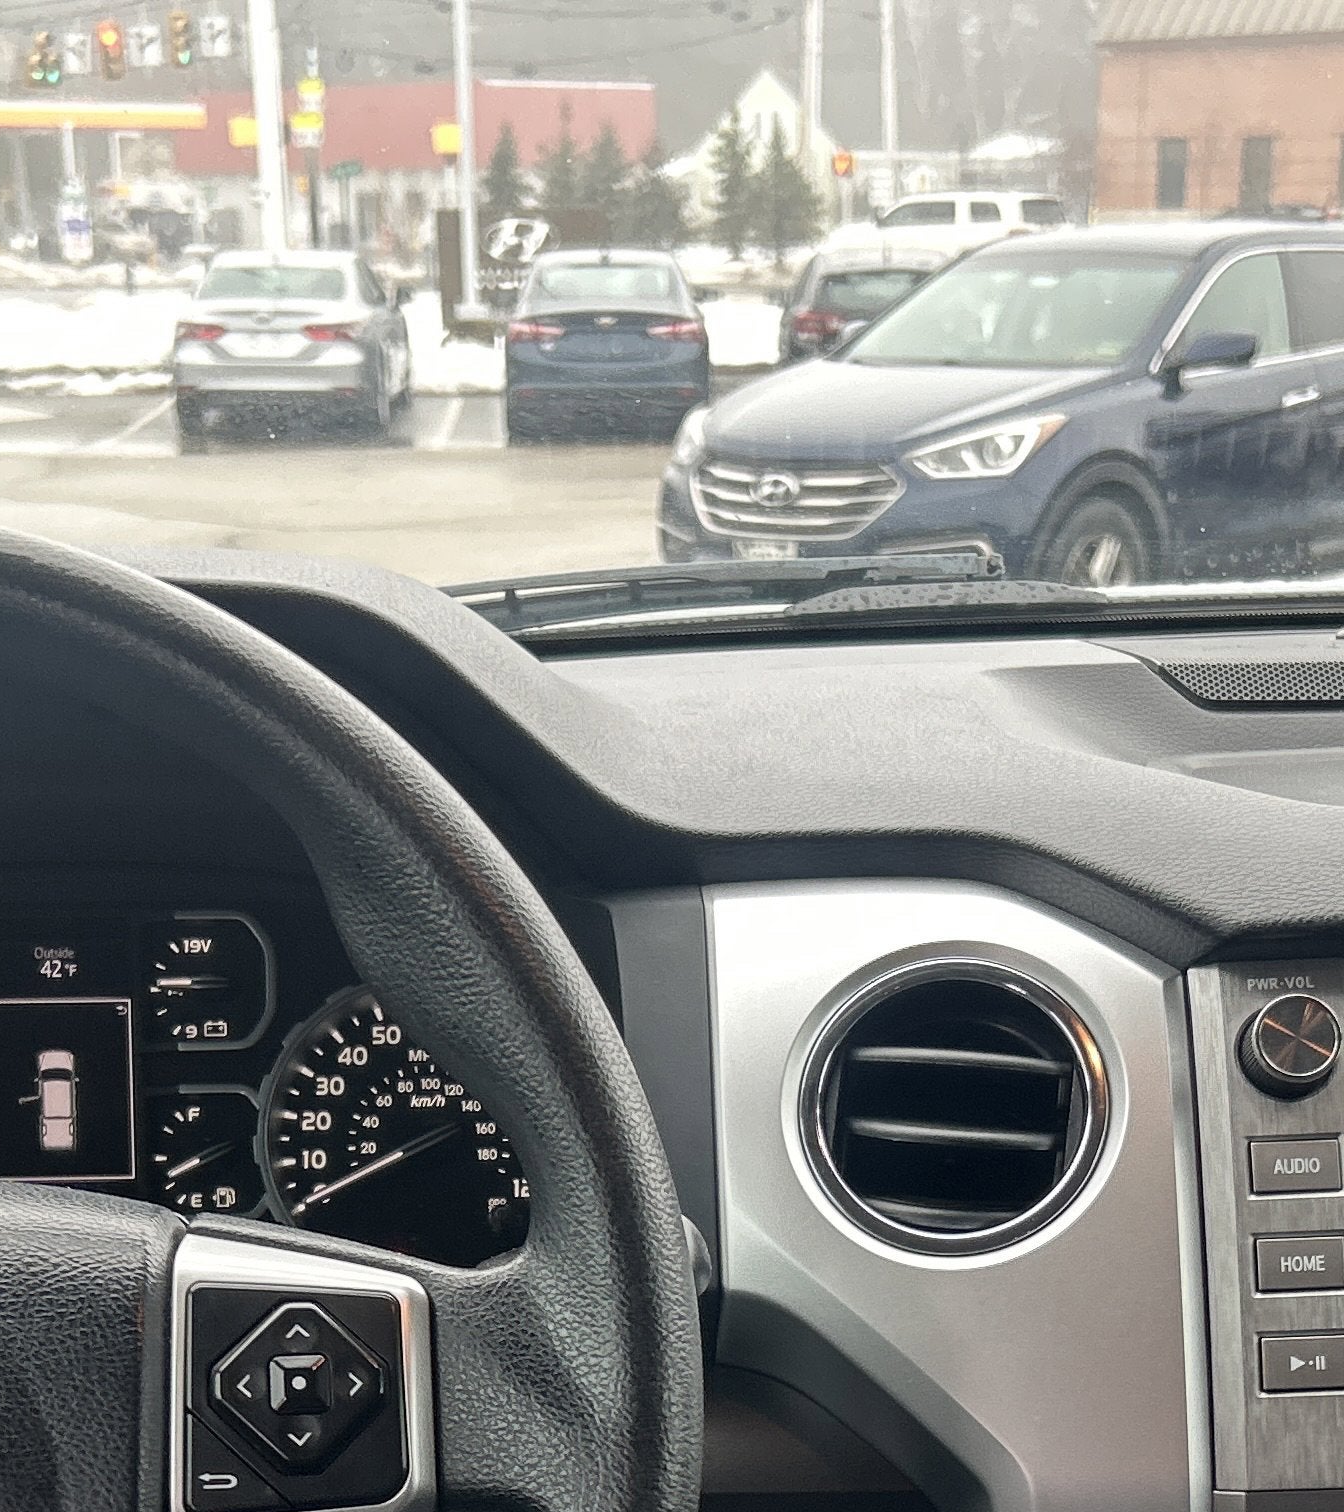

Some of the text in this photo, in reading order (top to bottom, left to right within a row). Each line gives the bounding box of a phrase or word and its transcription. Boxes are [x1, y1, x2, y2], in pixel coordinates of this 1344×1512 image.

[33, 946, 76, 960] Outside
[183, 939, 212, 954] 19V
[185, 1025, 198, 1039] 9
[372, 1025, 402, 1046] 50
[337, 1047, 369, 1067] 40
[315, 1077, 346, 1096] 30
[397, 1080, 414, 1093] 80
[420, 1077, 441, 1091] 100
[444, 1083, 465, 1096] 120
[375, 1094, 393, 1107] 60
[410, 1094, 447, 1109] km/h
[460, 1100, 482, 1113] 140
[187, 1107, 201, 1122] F
[300, 1111, 332, 1131] 20
[361, 1115, 380, 1129] 40
[475, 1121, 496, 1135] 160
[359, 1141, 378, 1155] 20
[477, 1148, 498, 1162] 180
[301, 1149, 327, 1170] 10
[1273, 1157, 1321, 1175] AUDIO
[190, 1194, 203, 1209] E
[1280, 1255, 1326, 1273] HOME
